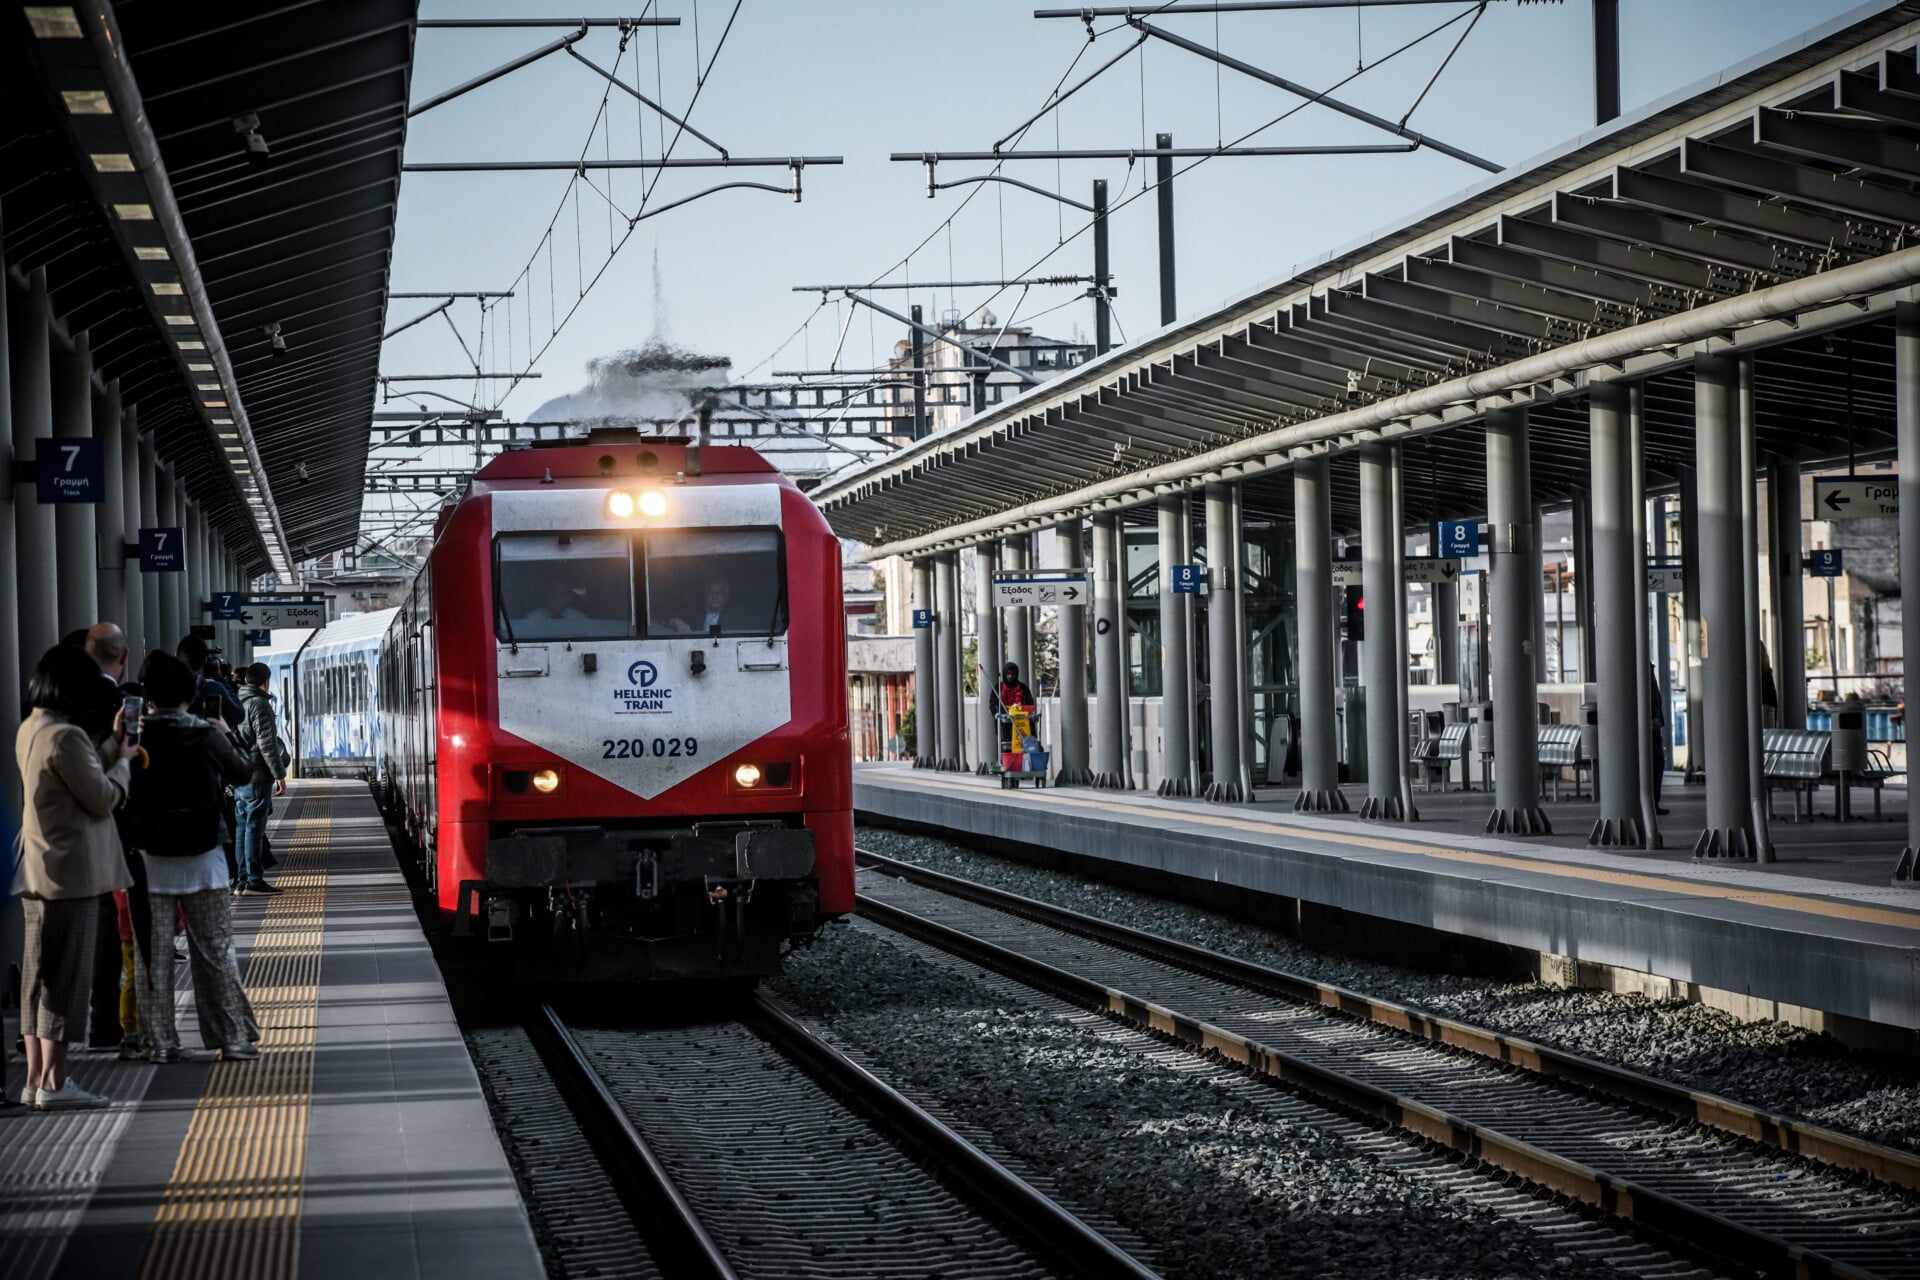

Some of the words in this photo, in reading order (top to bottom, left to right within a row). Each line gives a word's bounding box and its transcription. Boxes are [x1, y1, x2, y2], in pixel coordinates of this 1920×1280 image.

[60, 446, 80, 471] 7
[54, 477, 89, 487] Γραμμή
[1864, 486, 1899, 500] Γραμ
[1455, 525, 1465, 540] 8
[154, 533, 167, 550] 7
[1823, 552, 1832, 564] 9
[1182, 568, 1191, 580] 8
[1331, 564, 1353, 574] ξοδος
[1000, 586, 1032, 595] Έξοδος
[222, 595, 231, 607] 7
[286, 608, 319, 617] Έξοδος
[613, 689, 672, 699] HELLENIC
[624, 700, 663, 710] TRAIN
